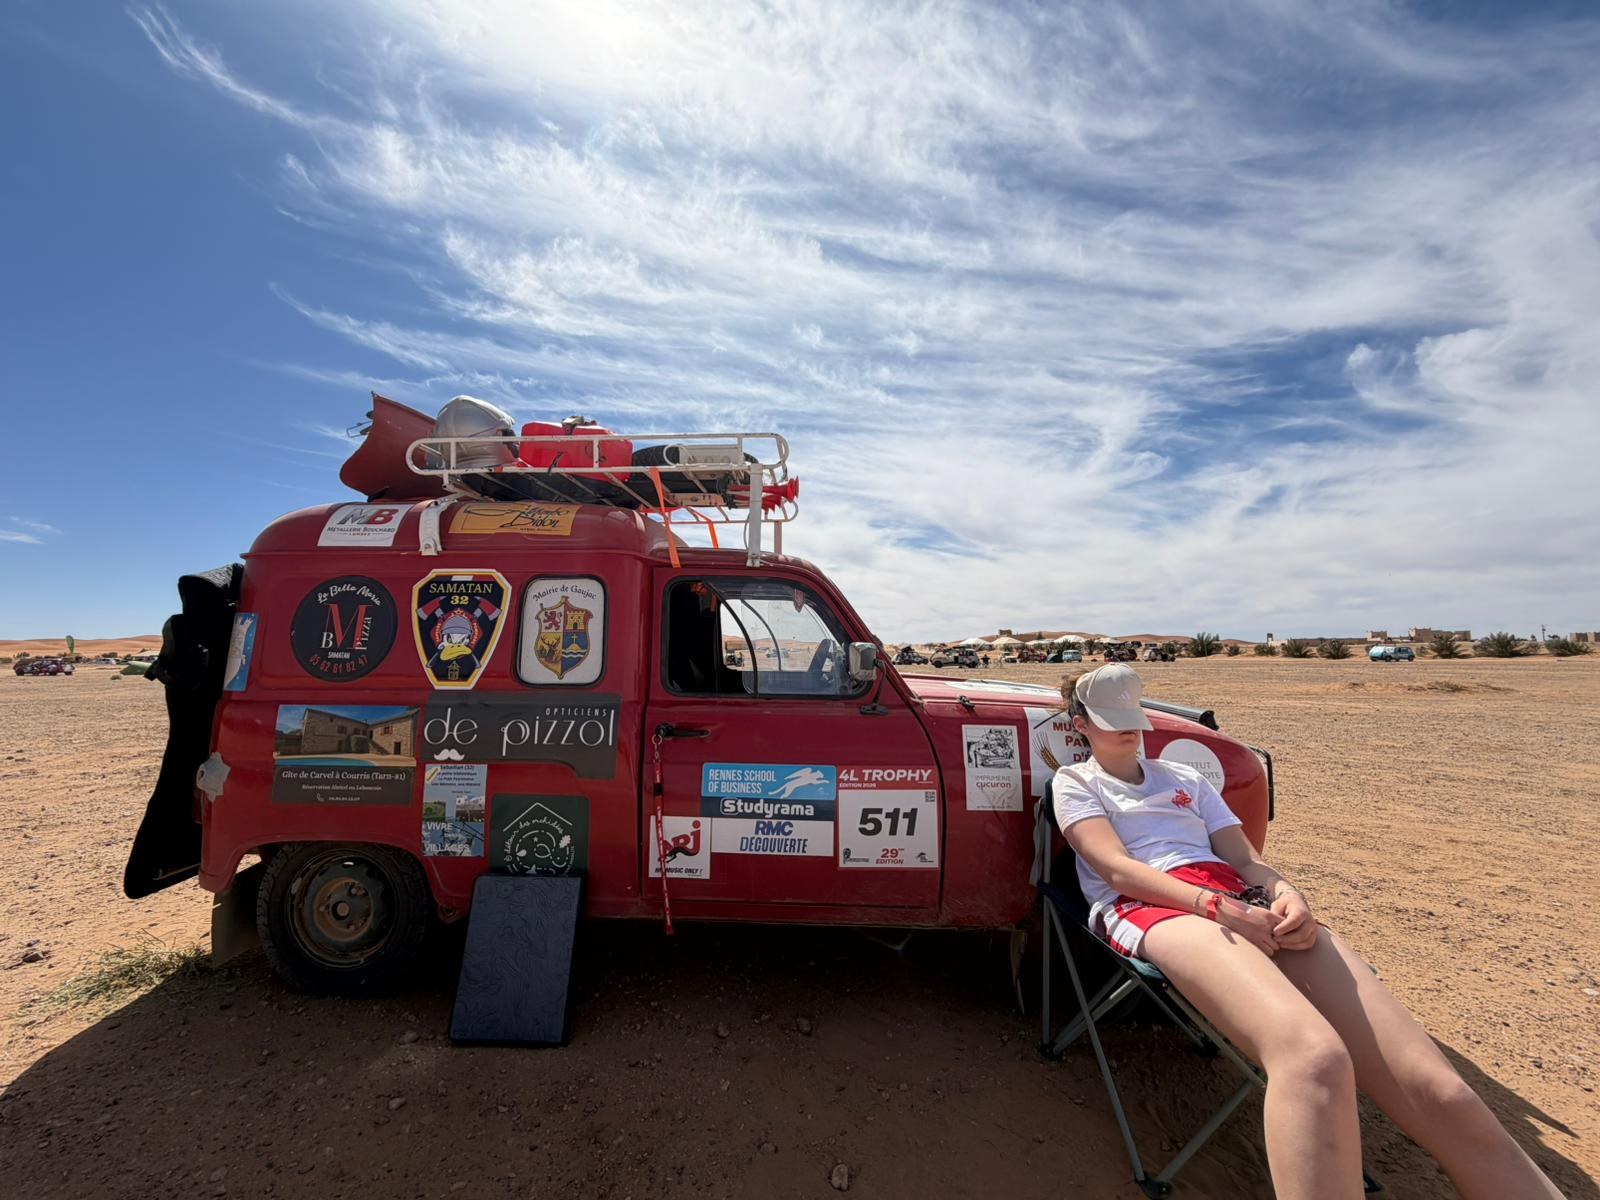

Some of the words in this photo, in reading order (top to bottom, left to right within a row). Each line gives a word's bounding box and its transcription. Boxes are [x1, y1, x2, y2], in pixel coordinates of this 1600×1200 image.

[428, 583, 493, 593] SAMATAN
[532, 585, 559, 601] Mairie
[560, 584, 569, 593] de
[570, 584, 597, 600] Gaujac
[329, 584, 357, 597] Belle
[356, 586, 381, 606] Marie
[450, 595, 469, 605] 32
[355, 616, 372, 650] PIZZA
[327, 651, 351, 659] SAMATAN
[545, 707, 608, 717] OPTICIENS
[423, 707, 478, 745] de
[500, 709, 615, 756] pizzol
[299, 770, 309, 779] de
[309, 770, 334, 779] Carvel
[341, 771, 370, 780] Courris
[708, 768, 743, 782] RENNES
[744, 769, 777, 783] SCHOOL
[839, 769, 858, 781] 4L
[862, 769, 932, 781] TROPHY
[708, 781, 720, 793] OF
[721, 781, 762, 794] BUSINESS
[721, 798, 815, 818] Studyrama
[427, 821, 453, 831] VIVRE
[754, 820, 794, 836] RMC
[858, 807, 918, 836] 511
[424, 843, 469, 852] VILLAGES
